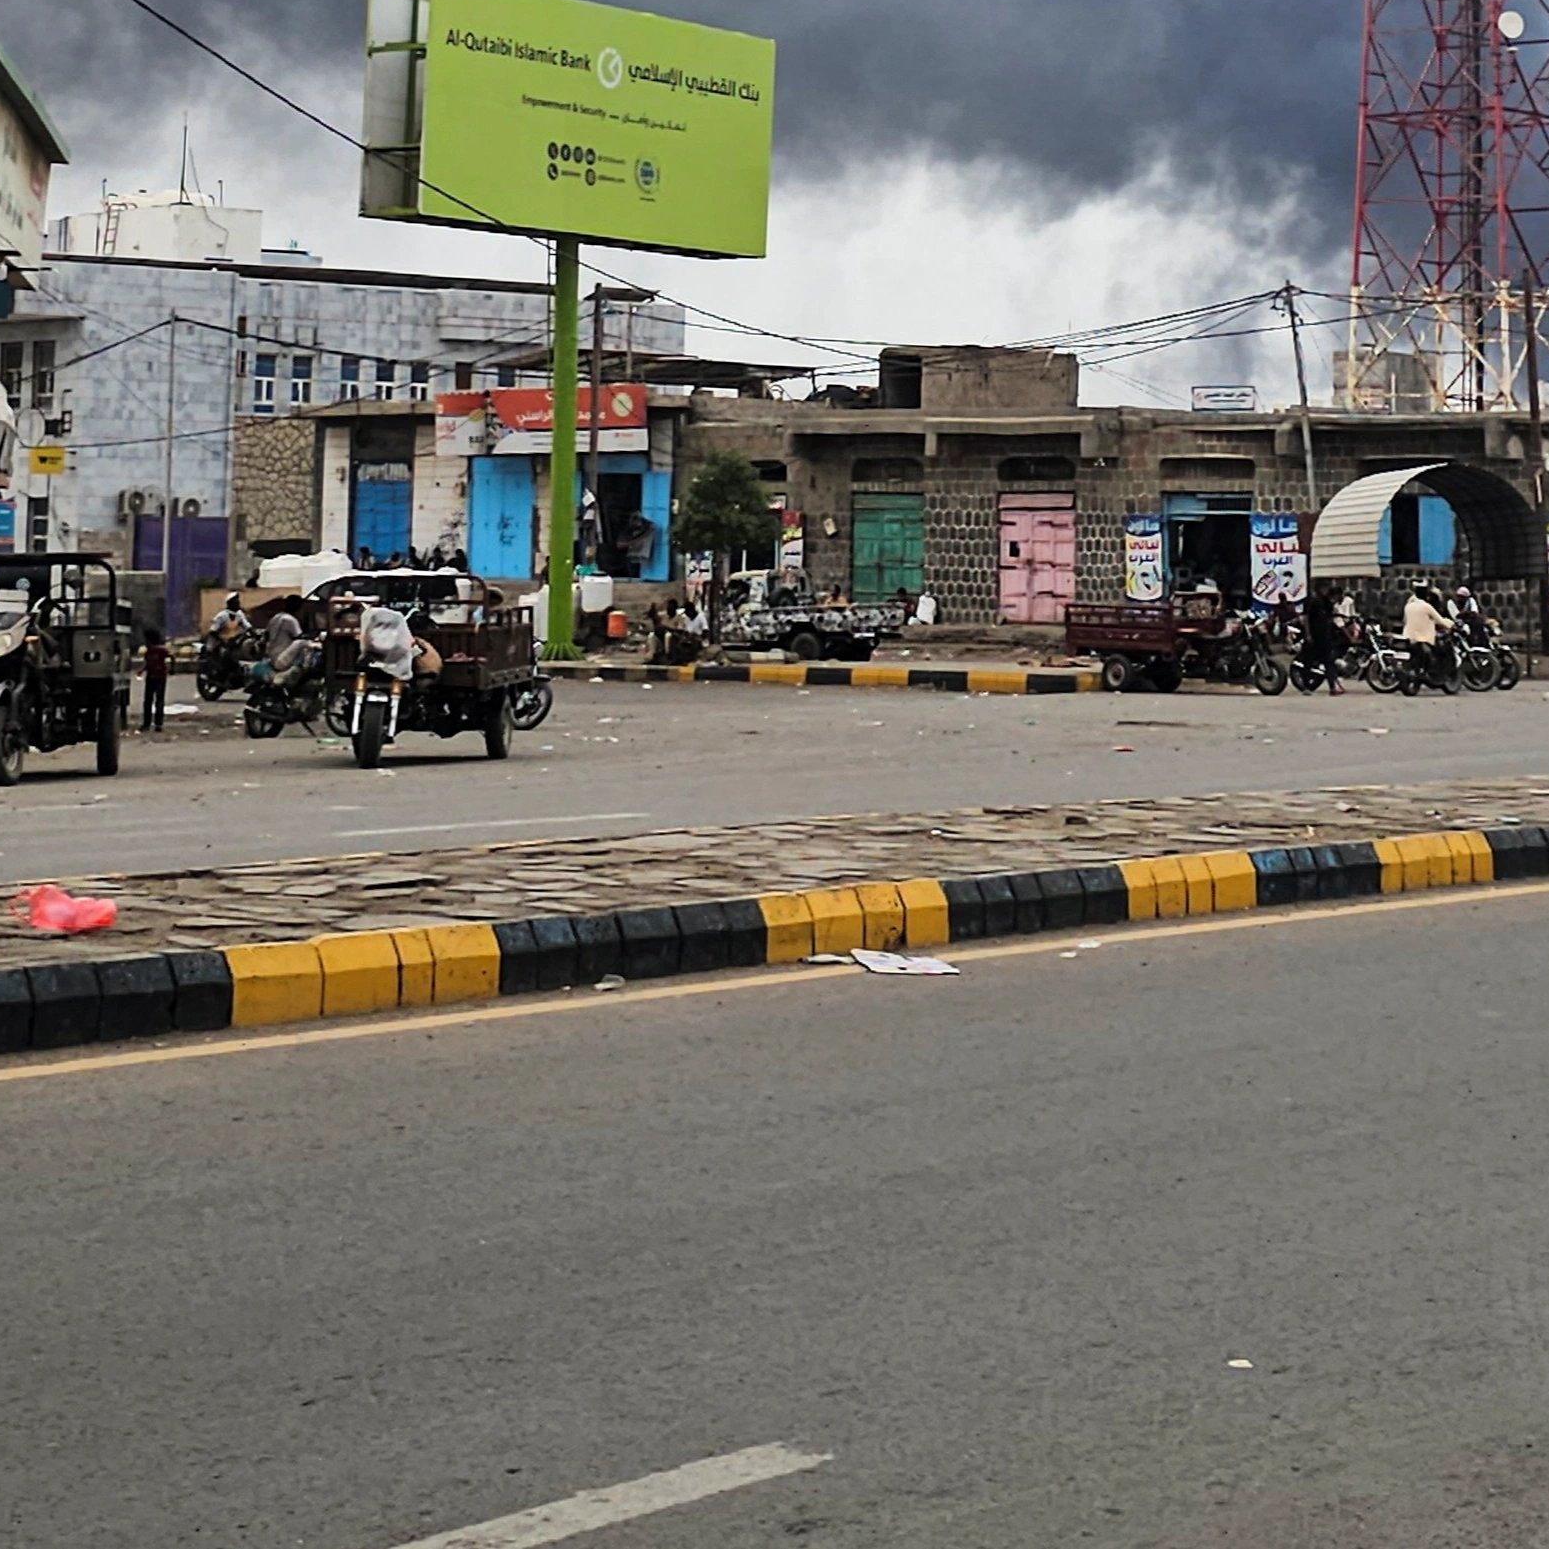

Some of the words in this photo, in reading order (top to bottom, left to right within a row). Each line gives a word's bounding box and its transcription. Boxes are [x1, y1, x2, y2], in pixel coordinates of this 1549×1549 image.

[445, 29, 513, 57] Al-Qutaibi
[514, 42, 558, 66] Islamic
[560, 50, 592, 72] Bank
[627, 63, 684, 93] الإسلامي
[685, 74, 737, 99] القطيبي
[738, 83, 760, 106] بنك
